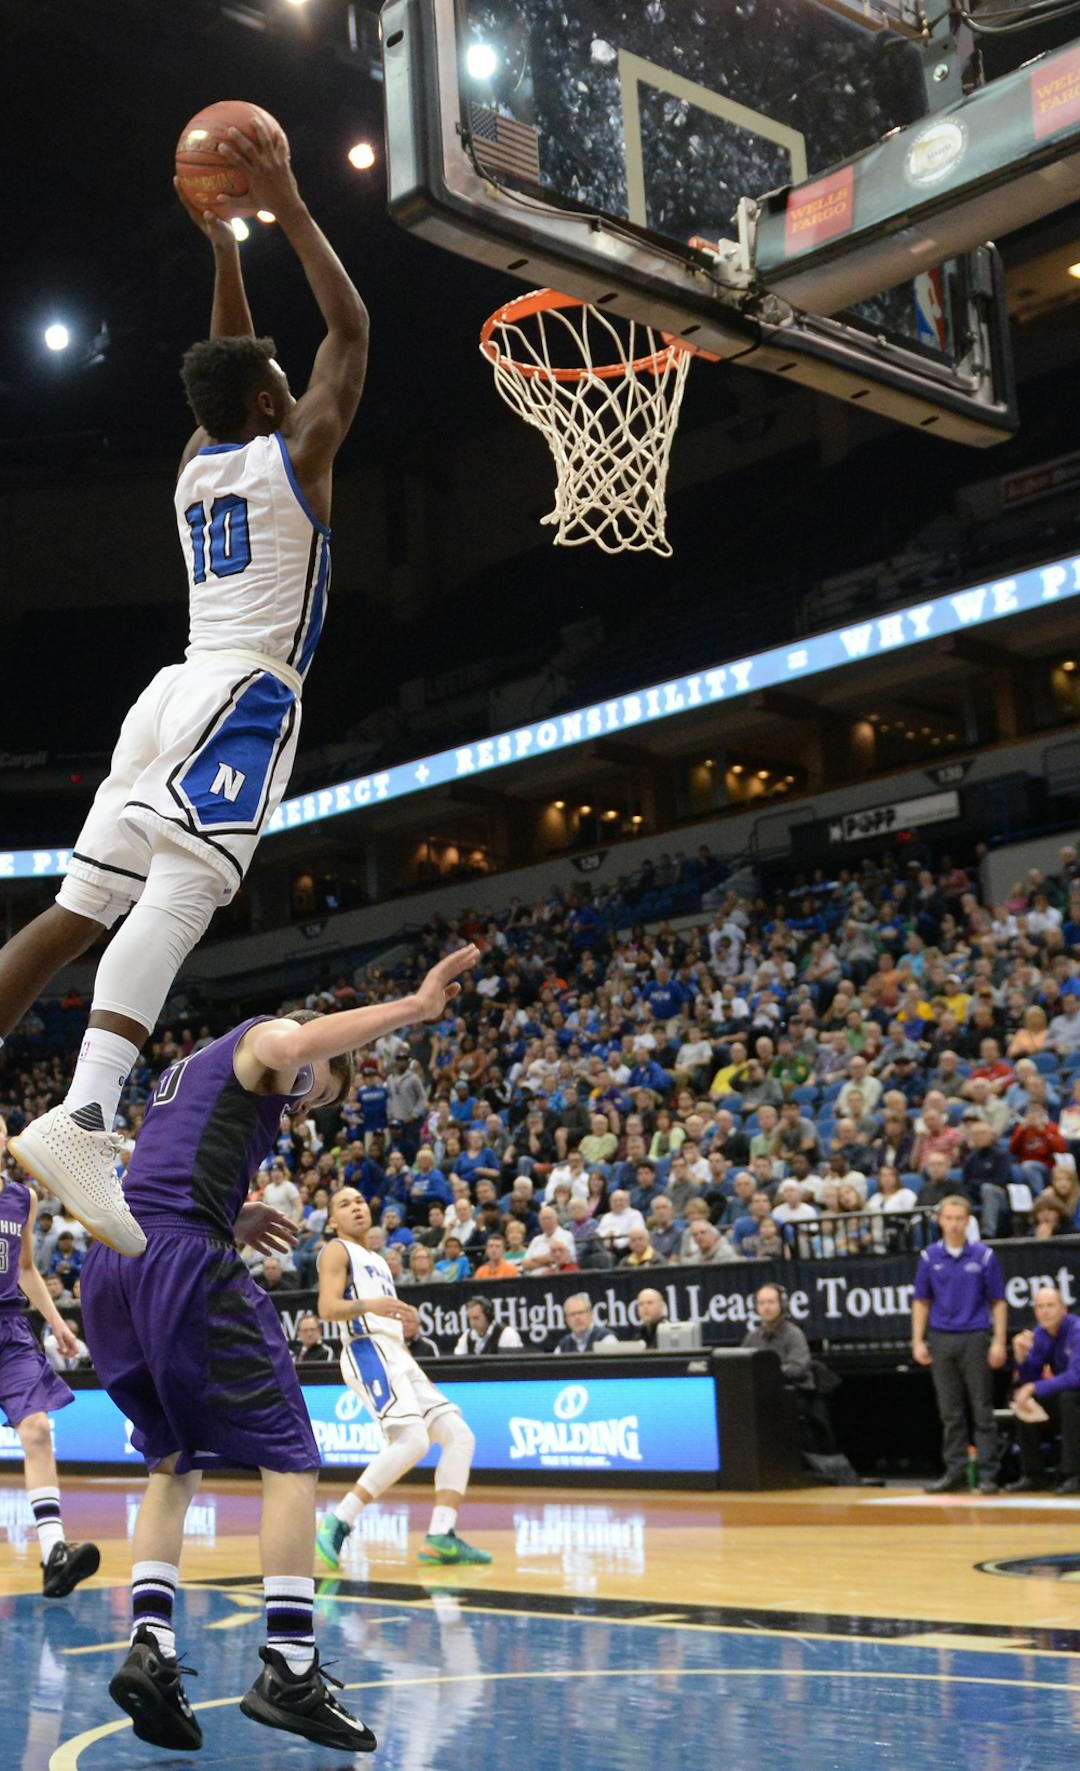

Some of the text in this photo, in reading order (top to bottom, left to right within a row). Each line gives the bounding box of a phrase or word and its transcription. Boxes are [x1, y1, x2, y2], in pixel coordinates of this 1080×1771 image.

[1036, 68, 1080, 97] WEL
[791, 187, 849, 220] WELLS
[791, 202, 847, 234] FARGO
[184, 493, 253, 585] 10
[456, 660, 754, 774] RESPONSIBILITY
[839, 604, 934, 658] WHY
[950, 579, 1019, 623] WE
[209, 761, 246, 803] N
[420, 1301, 469, 1337] Stat
[493, 1292, 566, 1342] High
[592, 1284, 679, 1328] chol
[685, 1284, 810, 1332] Leage
[508, 1415, 643, 1461] SPALDING
